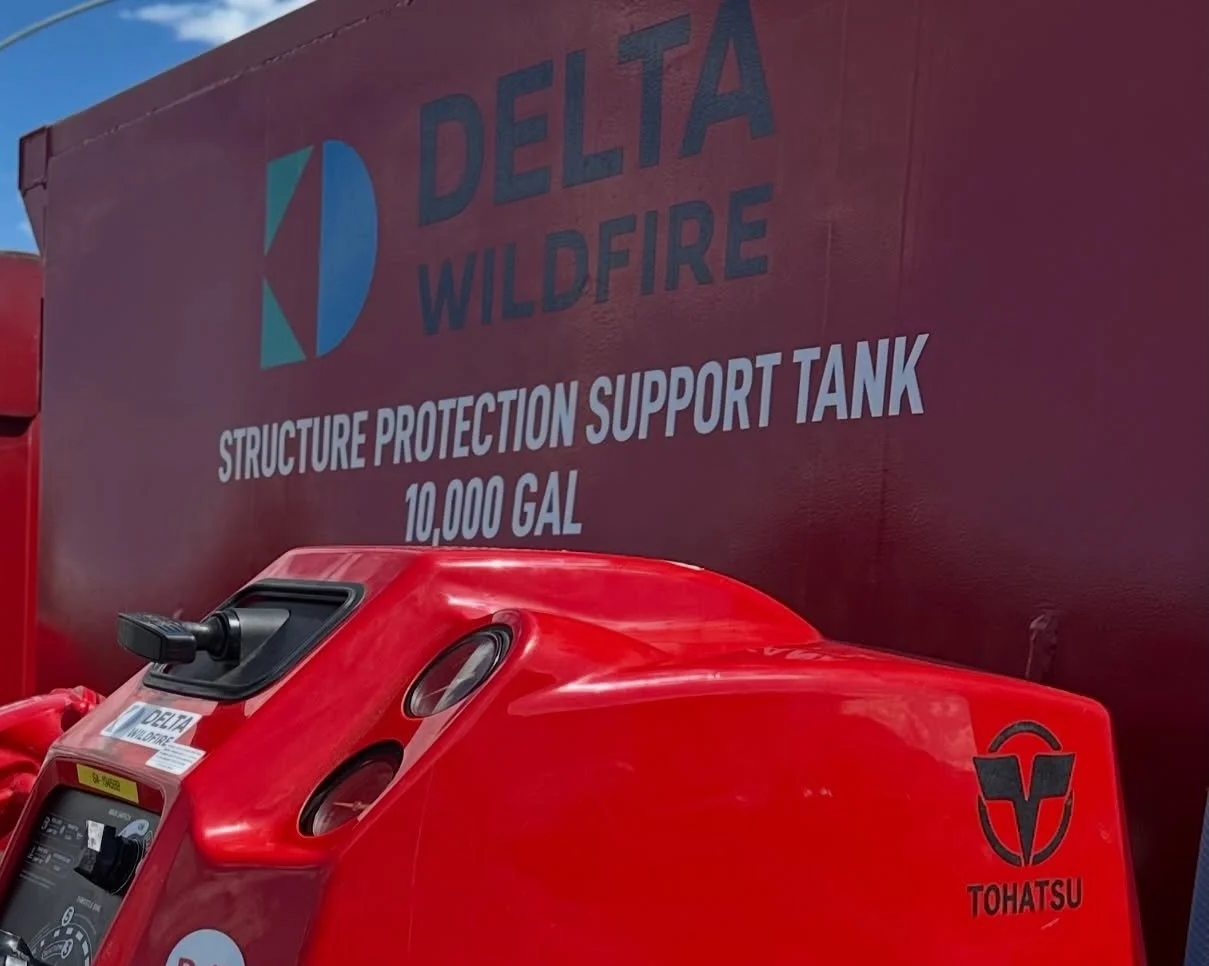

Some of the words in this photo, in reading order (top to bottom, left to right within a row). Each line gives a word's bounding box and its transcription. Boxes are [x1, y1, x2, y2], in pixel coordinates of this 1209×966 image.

[417, 0, 775, 227] DELTA
[417, 183, 773, 336] WILDFIRE
[218, 410, 367, 483] STRUCTURE
[374, 380, 576, 466] PROTECTION
[586, 352, 782, 447] SUPPORT
[793, 333, 930, 425] TANK
[404, 476, 503, 547] 10,000
[512, 470, 582, 537] GAL
[128, 727, 174, 747] WILDFIRE
[141, 709, 194, 733] DELTA
[967, 877, 1082, 918] TOHATSU
